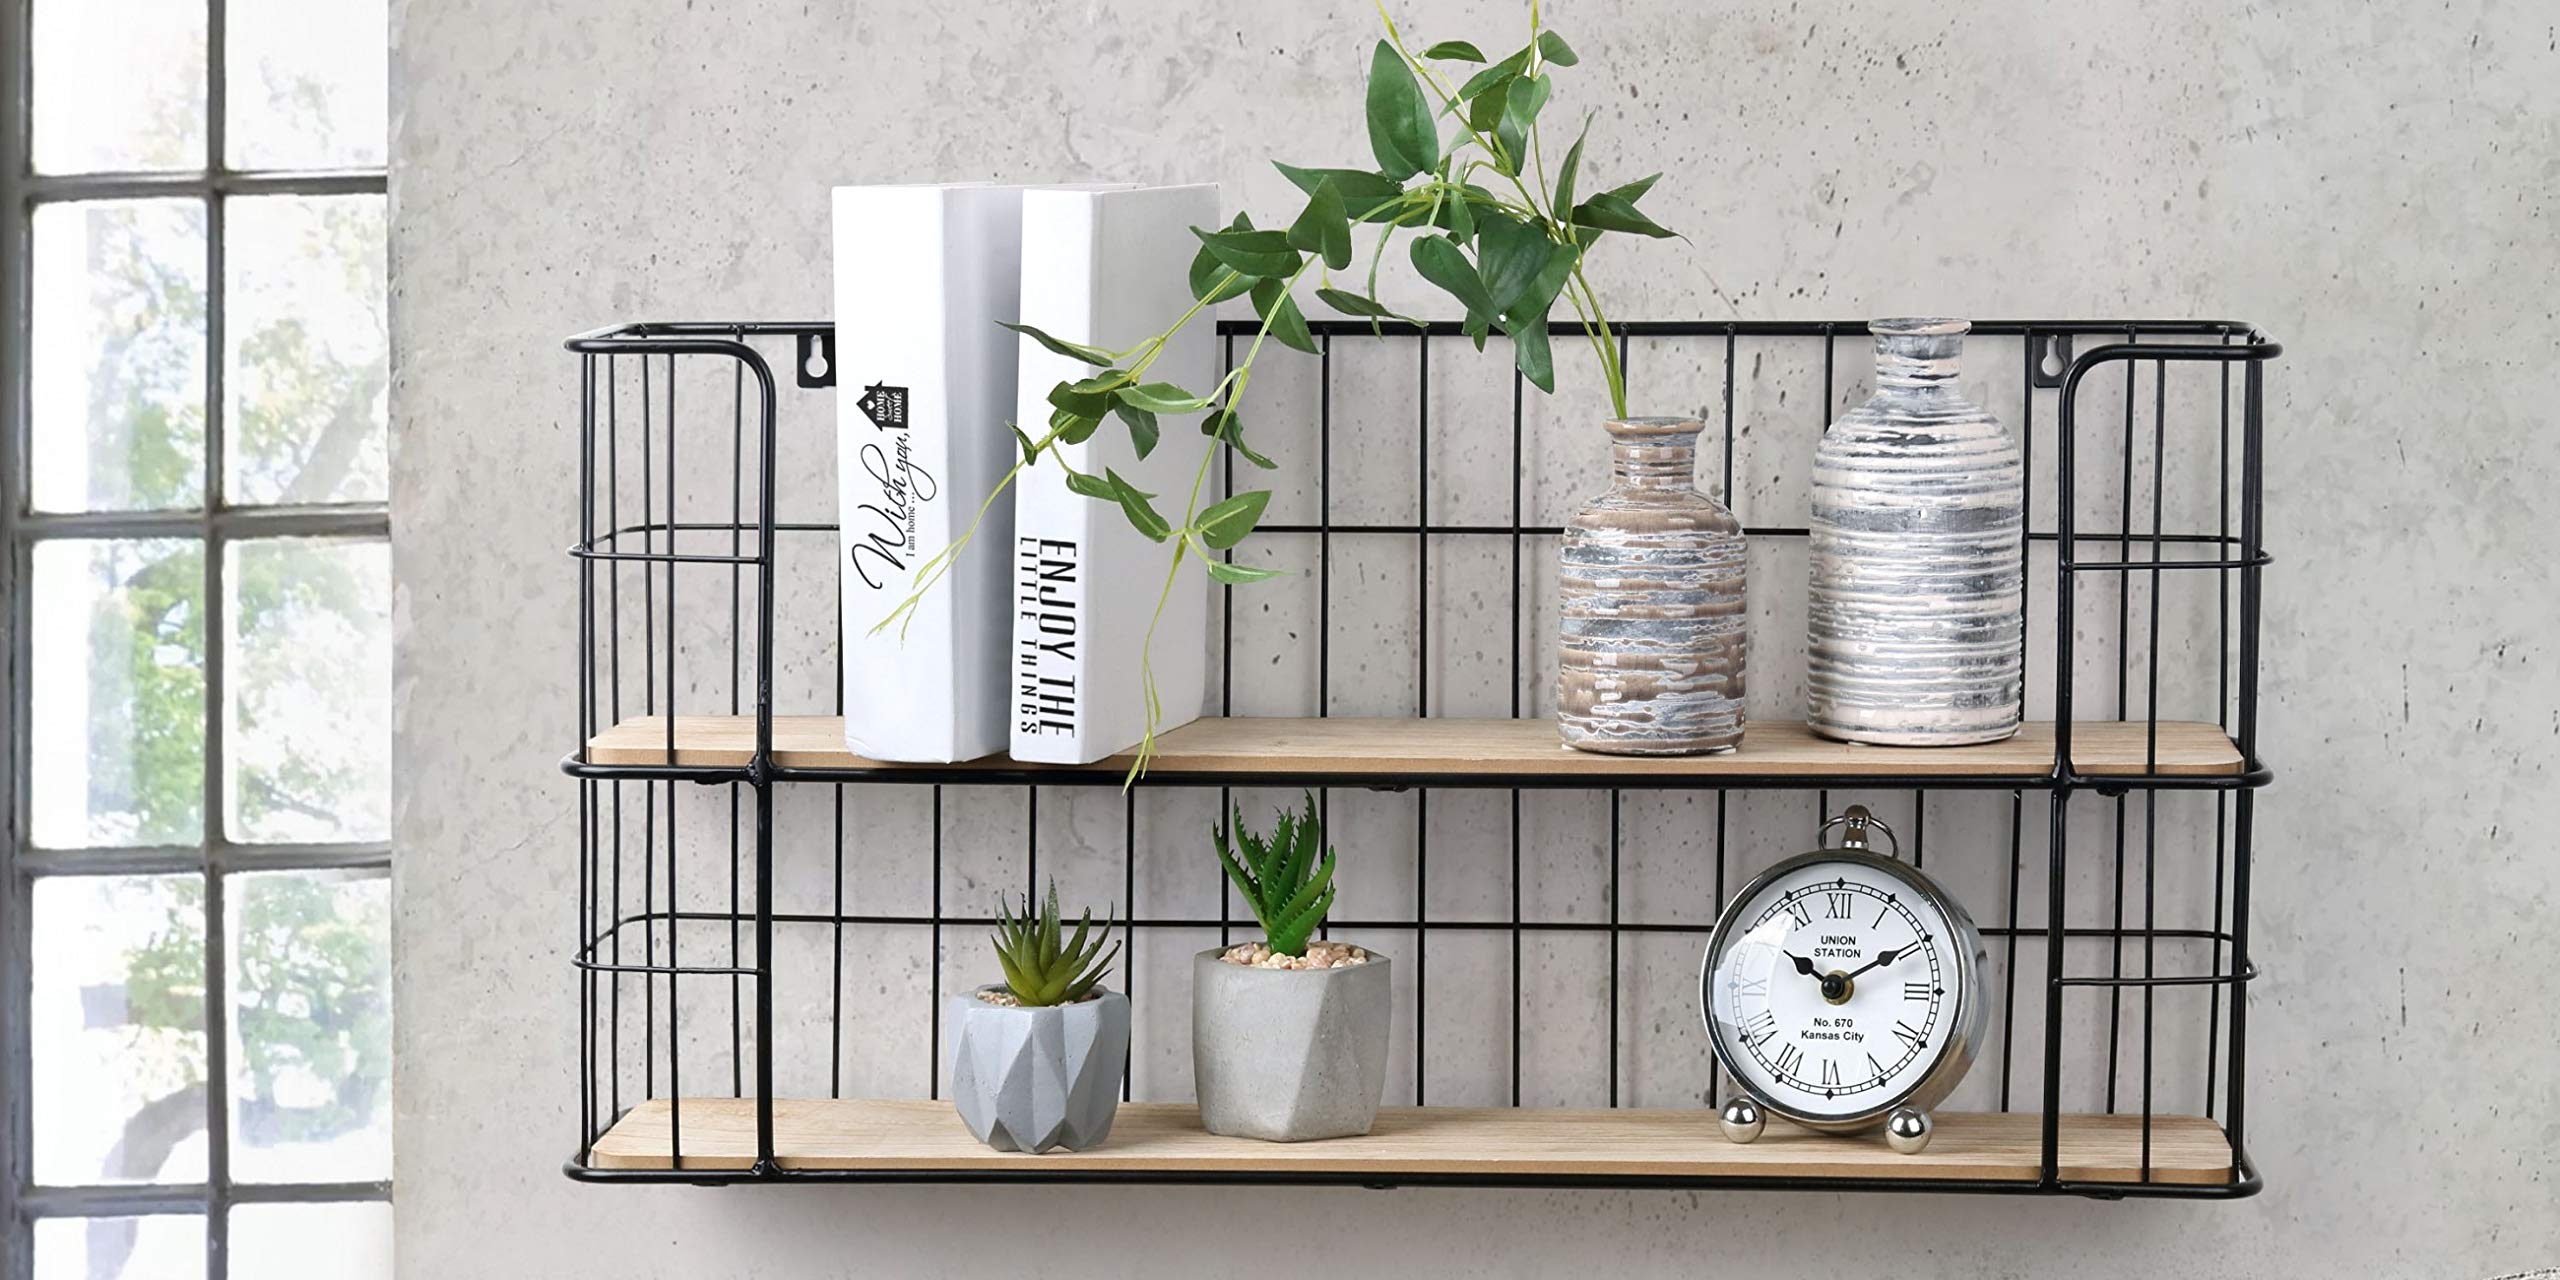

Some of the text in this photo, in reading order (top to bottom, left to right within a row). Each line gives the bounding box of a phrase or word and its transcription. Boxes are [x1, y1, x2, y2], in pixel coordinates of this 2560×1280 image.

[876, 390, 886, 421] HOME
[893, 392, 902, 422] HOME
[852, 432, 937, 590] With you,
[906, 506, 916, 533] home
[907, 535, 915, 551] am
[1020, 537, 1038, 734] LITTLE THINGS
[1039, 539, 1076, 738] ENJOY THE
[1825, 893, 1853, 919] XII
[1871, 907, 1889, 931] I
[1814, 947, 1861, 958] STATION
[1820, 935, 1857, 946] UNION
[1904, 982, 1930, 1002] III
[1813, 1017, 1854, 1028] No. 670
[1801, 1030, 1865, 1043] Kansas City
